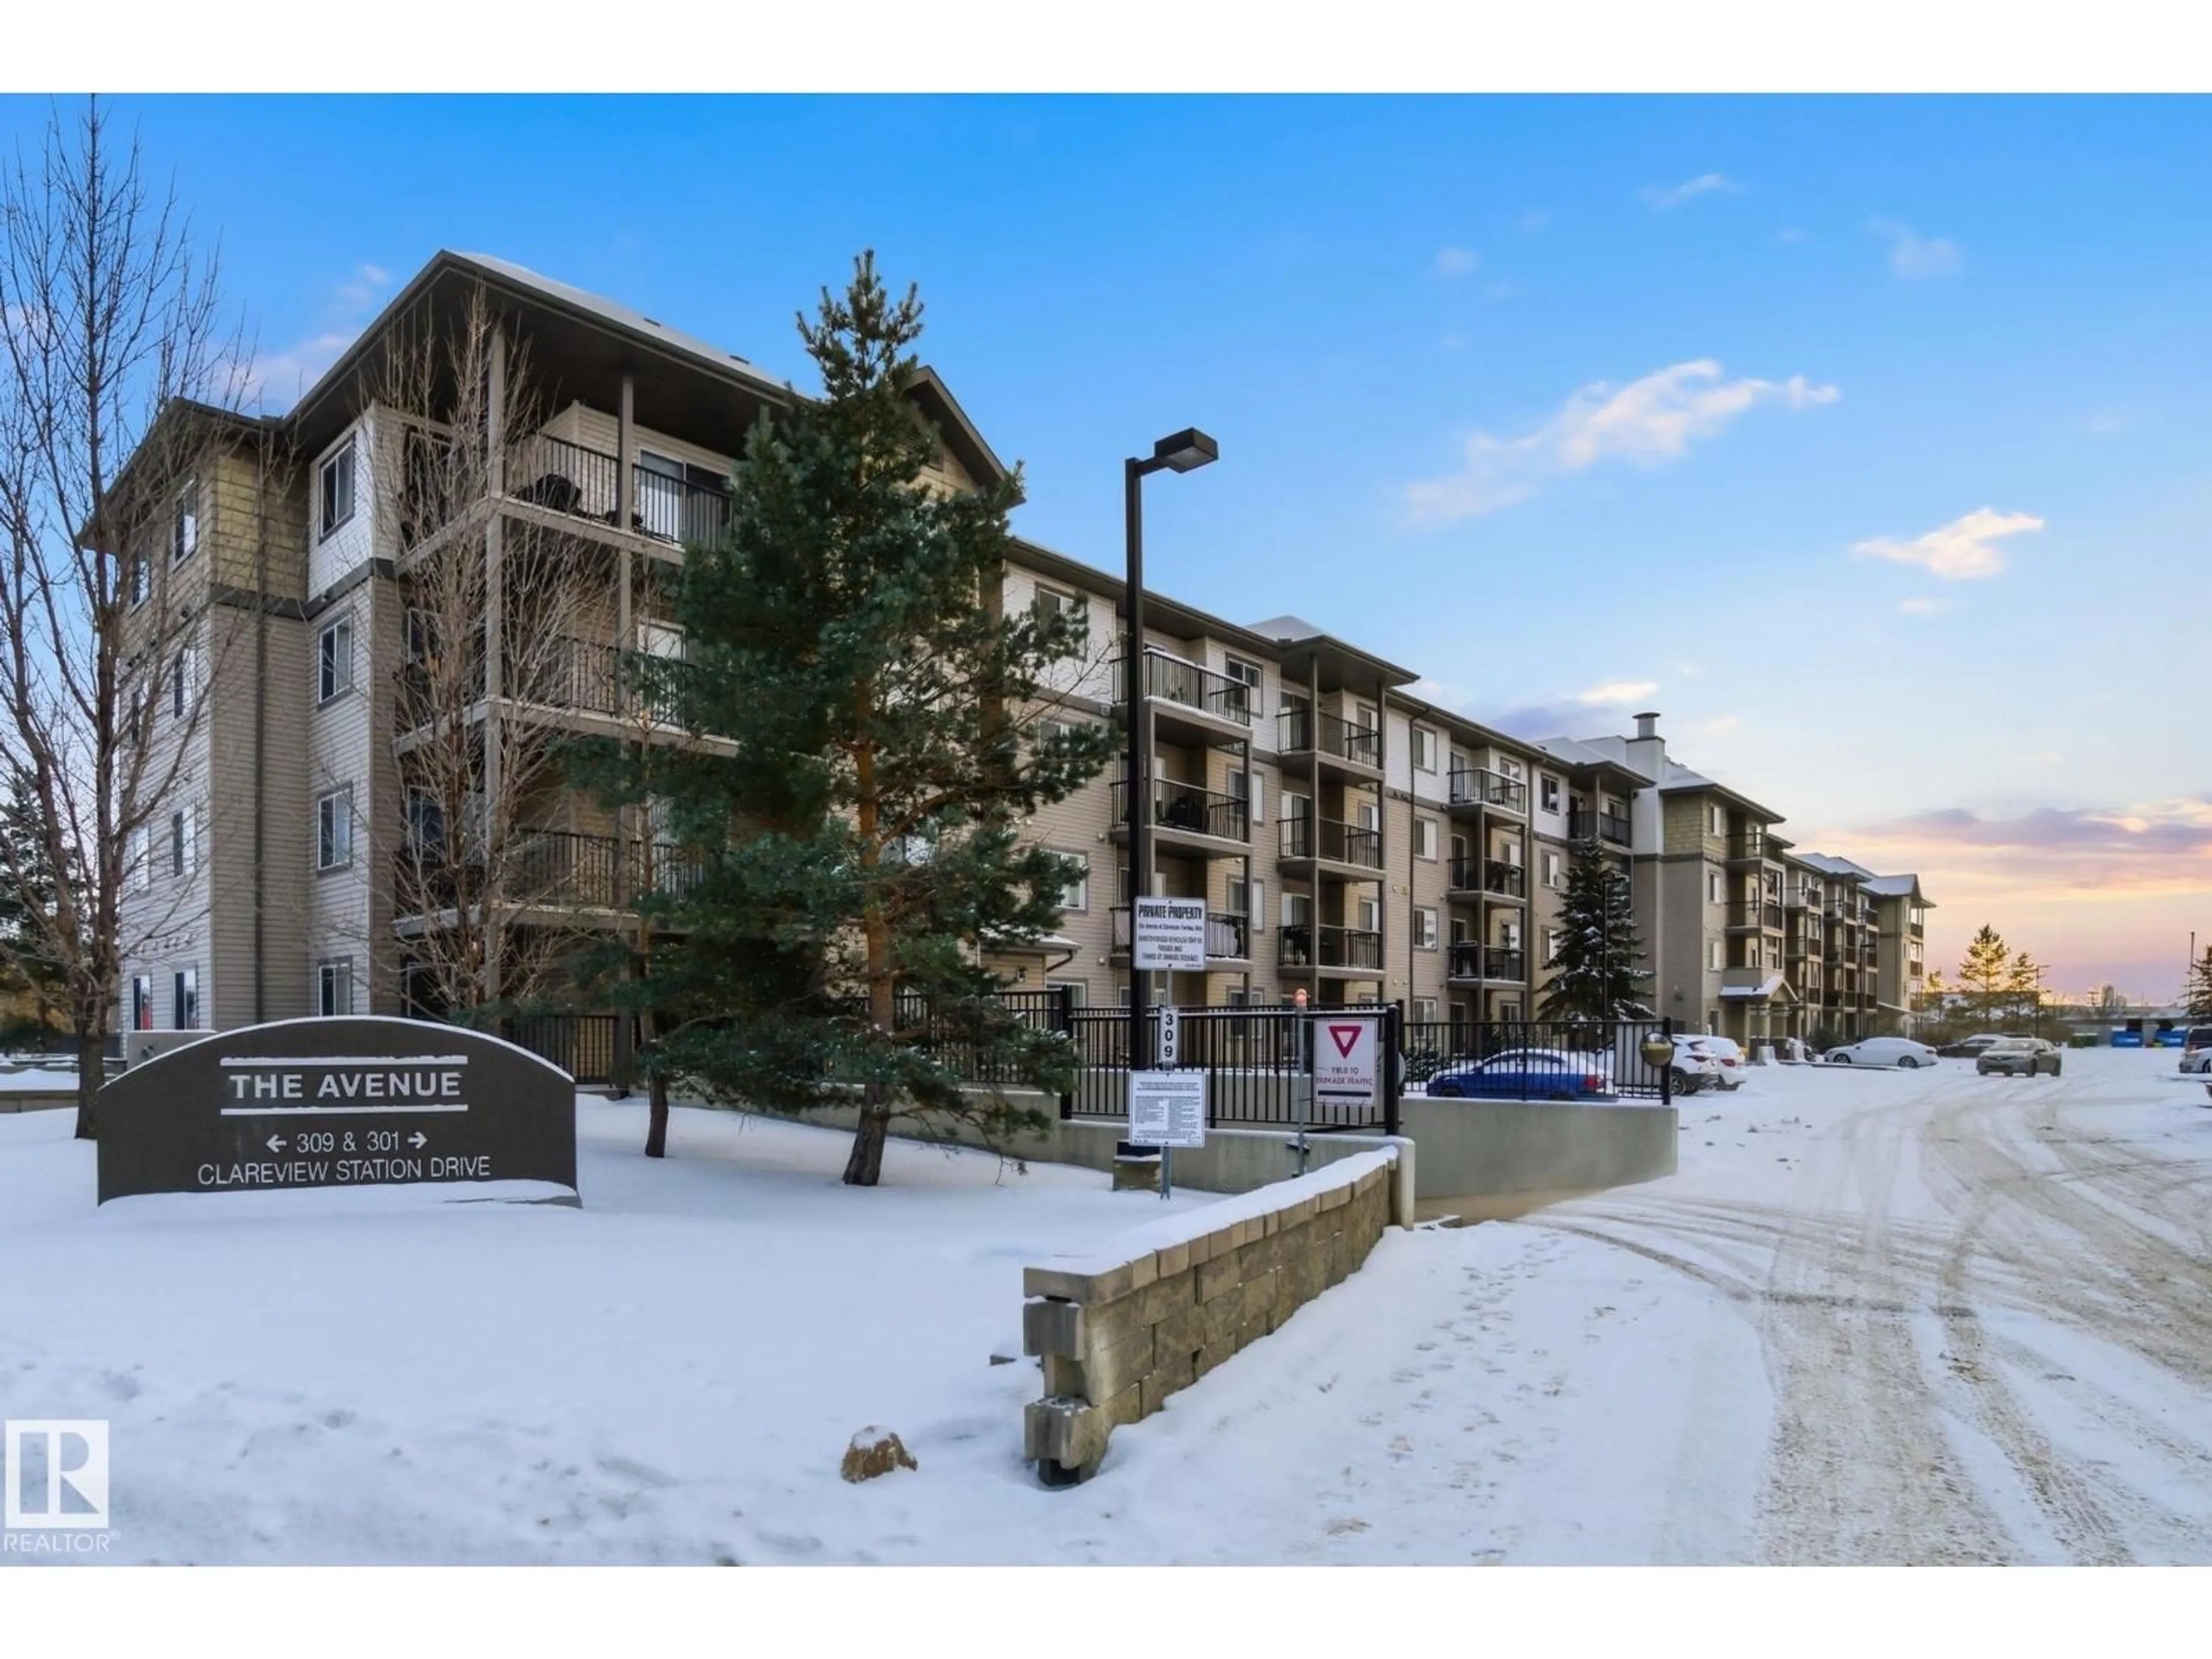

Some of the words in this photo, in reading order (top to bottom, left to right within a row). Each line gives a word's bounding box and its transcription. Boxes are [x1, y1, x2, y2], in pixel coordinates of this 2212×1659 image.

[1138, 904, 1166, 918] PRIVATE
[1168, 906, 1203, 919] PROPERTY
[1164, 1014, 1173, 1057] 309
[230, 1074, 303, 1099] THE
[317, 1071, 461, 1098] AVENUE
[297, 1132, 334, 1152] 309
[343, 1131, 357, 1151] &
[367, 1132, 400, 1151] 301
[197, 1161, 328, 1185] CLAREVIEW
[336, 1158, 422, 1180] STATION
[431, 1156, 491, 1177] DRIVE
